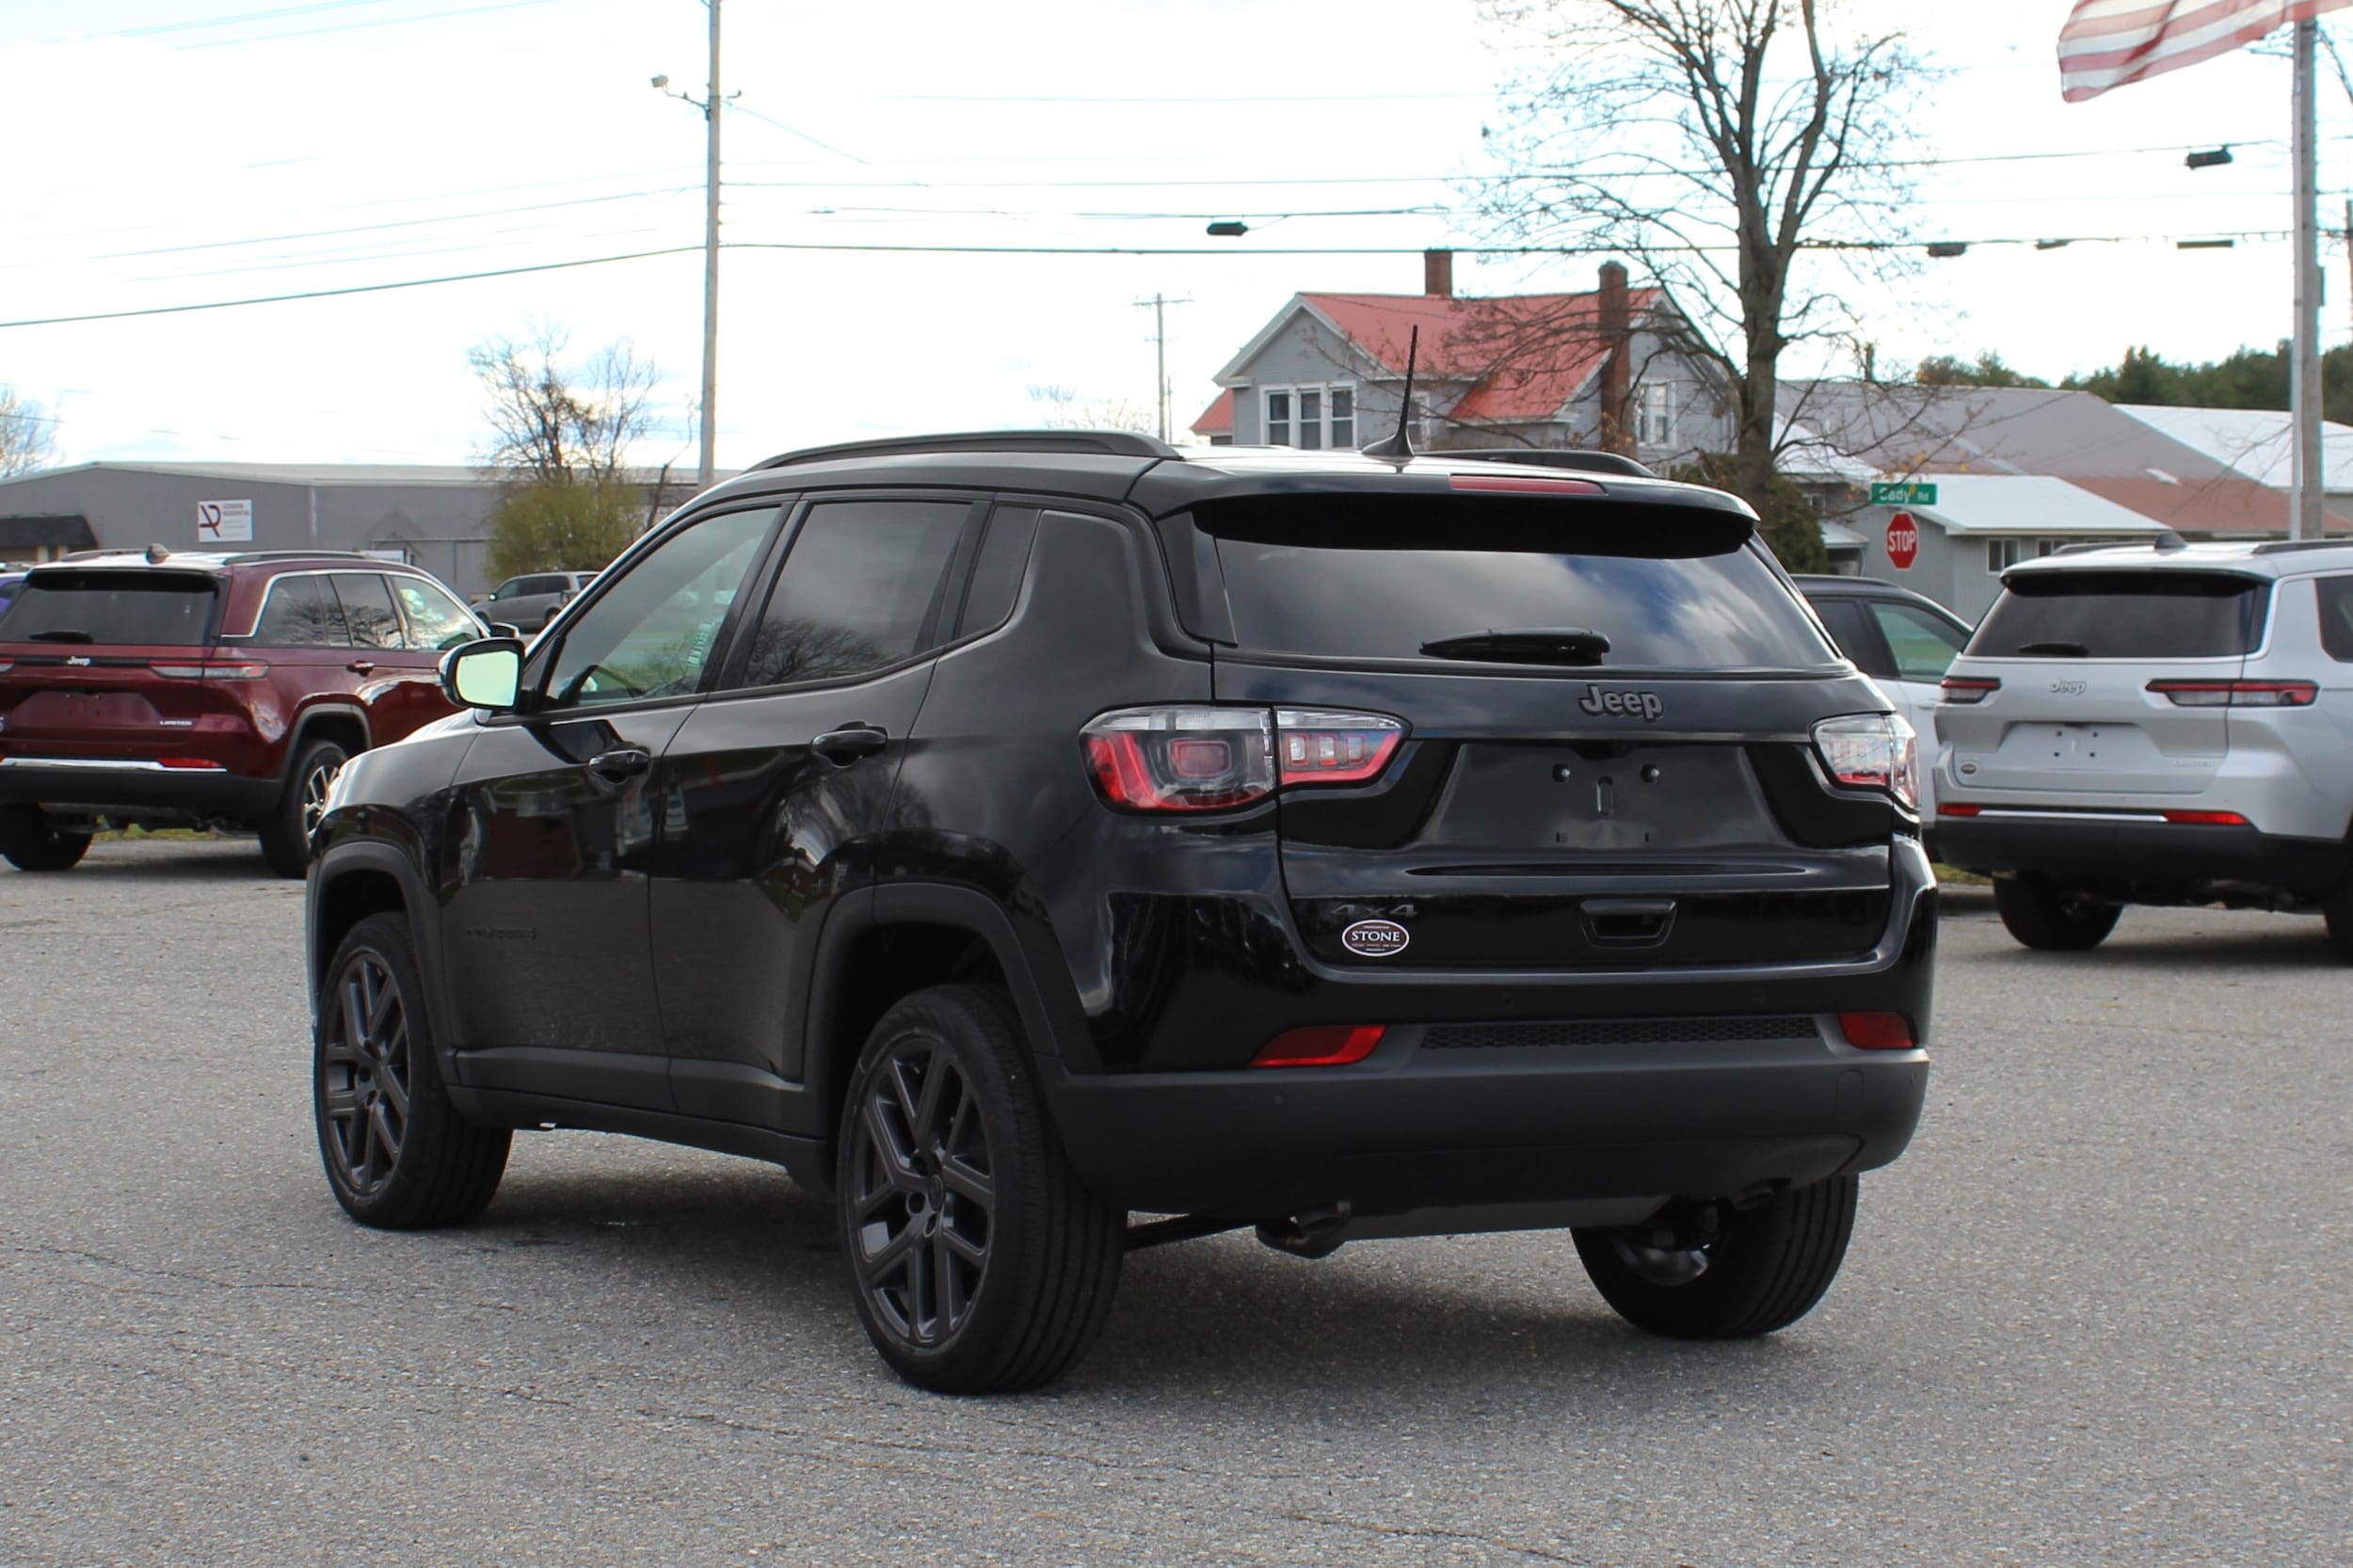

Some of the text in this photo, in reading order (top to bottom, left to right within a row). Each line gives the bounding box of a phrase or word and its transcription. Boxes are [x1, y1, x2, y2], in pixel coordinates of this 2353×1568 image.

[1879, 488, 1912, 504] Cady
[1888, 531, 1915, 552] STOP
[2050, 678, 2087, 696] Jeep
[1579, 684, 1663, 722] Jeep
[1331, 904, 1418, 918] 4x4
[1351, 930, 1401, 942] STONE
